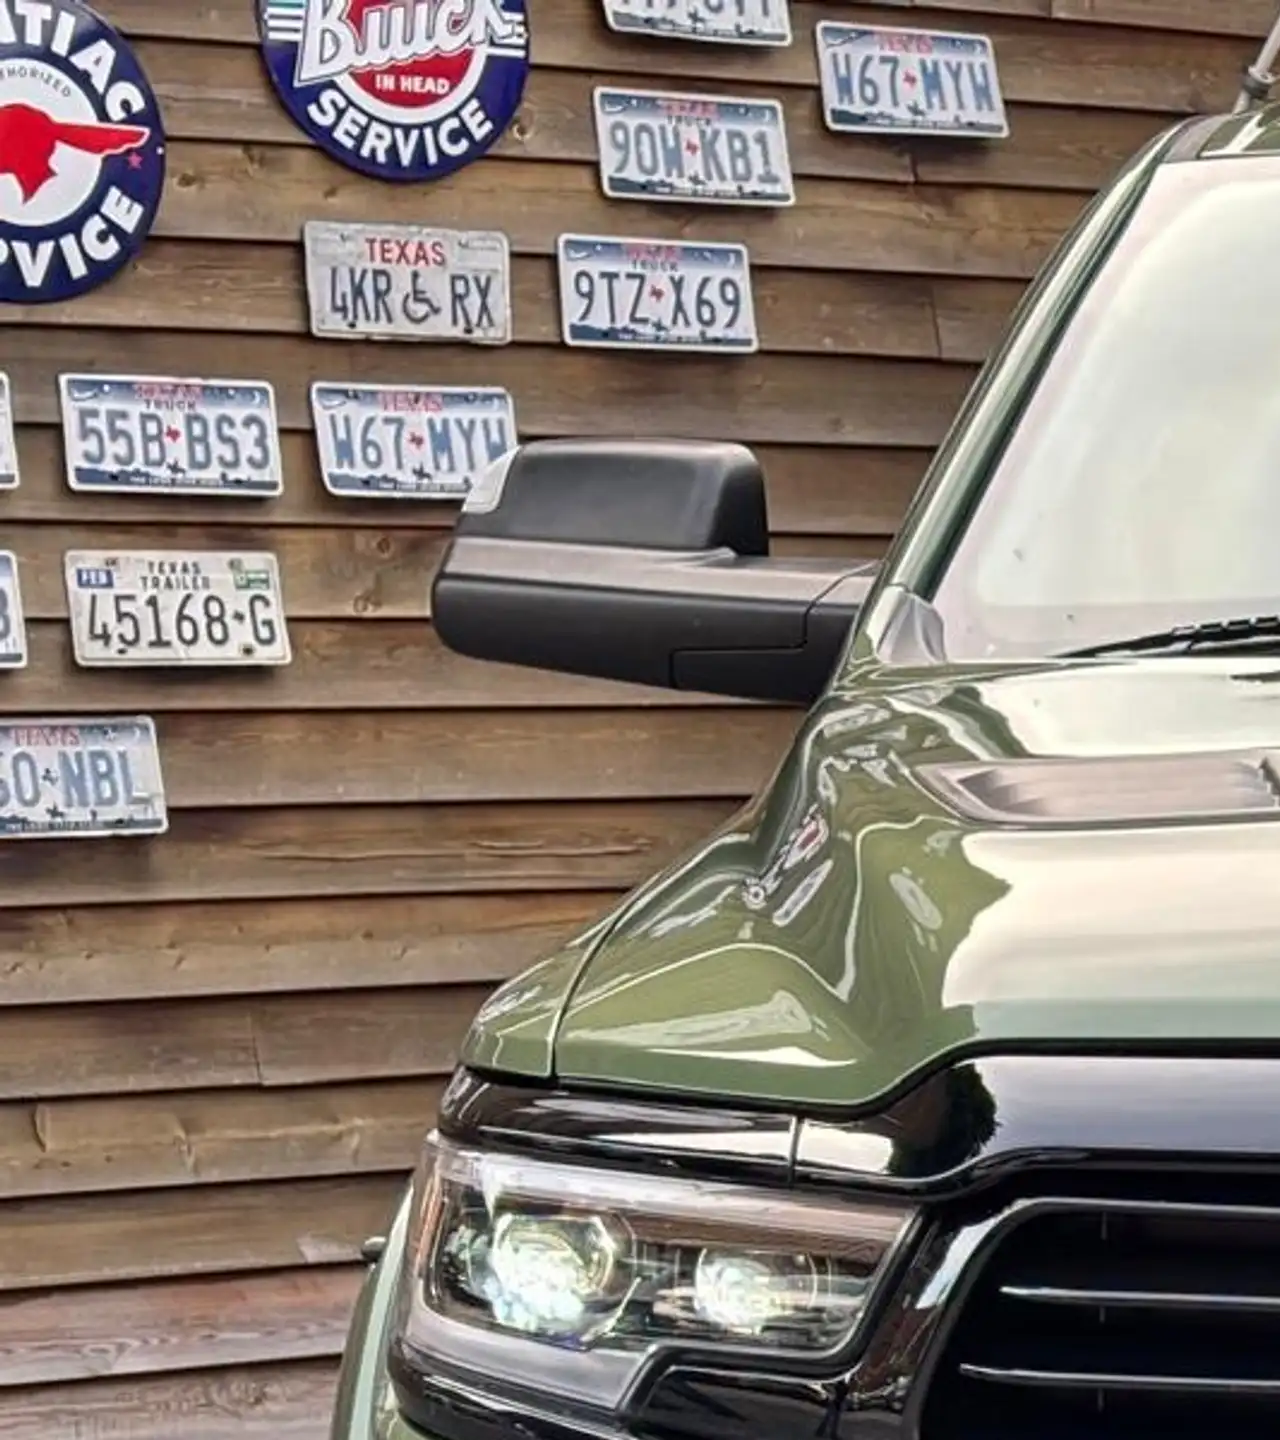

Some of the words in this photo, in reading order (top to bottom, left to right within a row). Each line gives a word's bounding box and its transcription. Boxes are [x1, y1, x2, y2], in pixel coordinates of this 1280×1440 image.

[375, 73, 395, 91] IN
[400, 74, 450, 96] HEAD
[307, 88, 494, 168] SERVICE
[365, 237, 447, 267] TEXAS
[450, 273, 496, 329] RX
[148, 560, 202, 574] TEXAS
[140, 576, 211, 591] TRAILER
